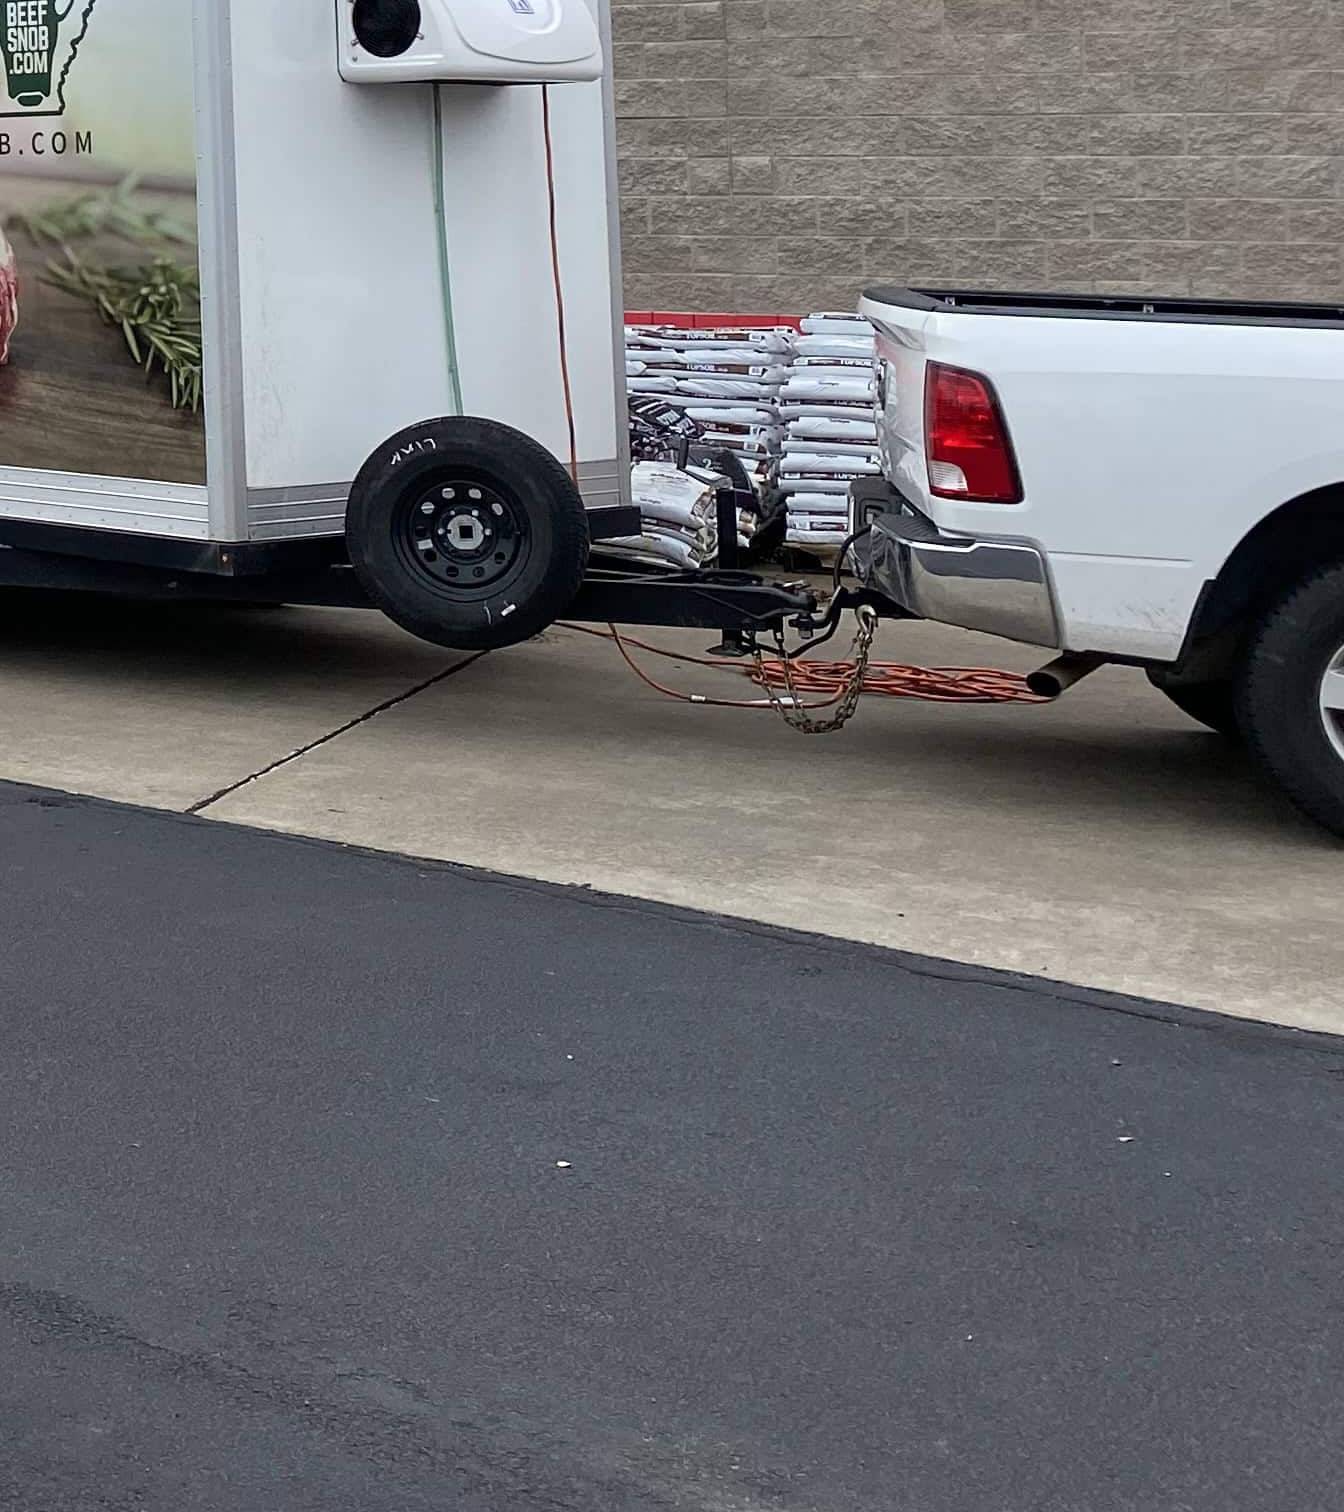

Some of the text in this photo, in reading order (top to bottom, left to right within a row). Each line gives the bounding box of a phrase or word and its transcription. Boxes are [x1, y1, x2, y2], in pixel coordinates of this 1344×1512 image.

[6, 0, 49, 26] BEEF
[7, 25, 49, 52] SNOB
[9, 52, 48, 75] .COM
